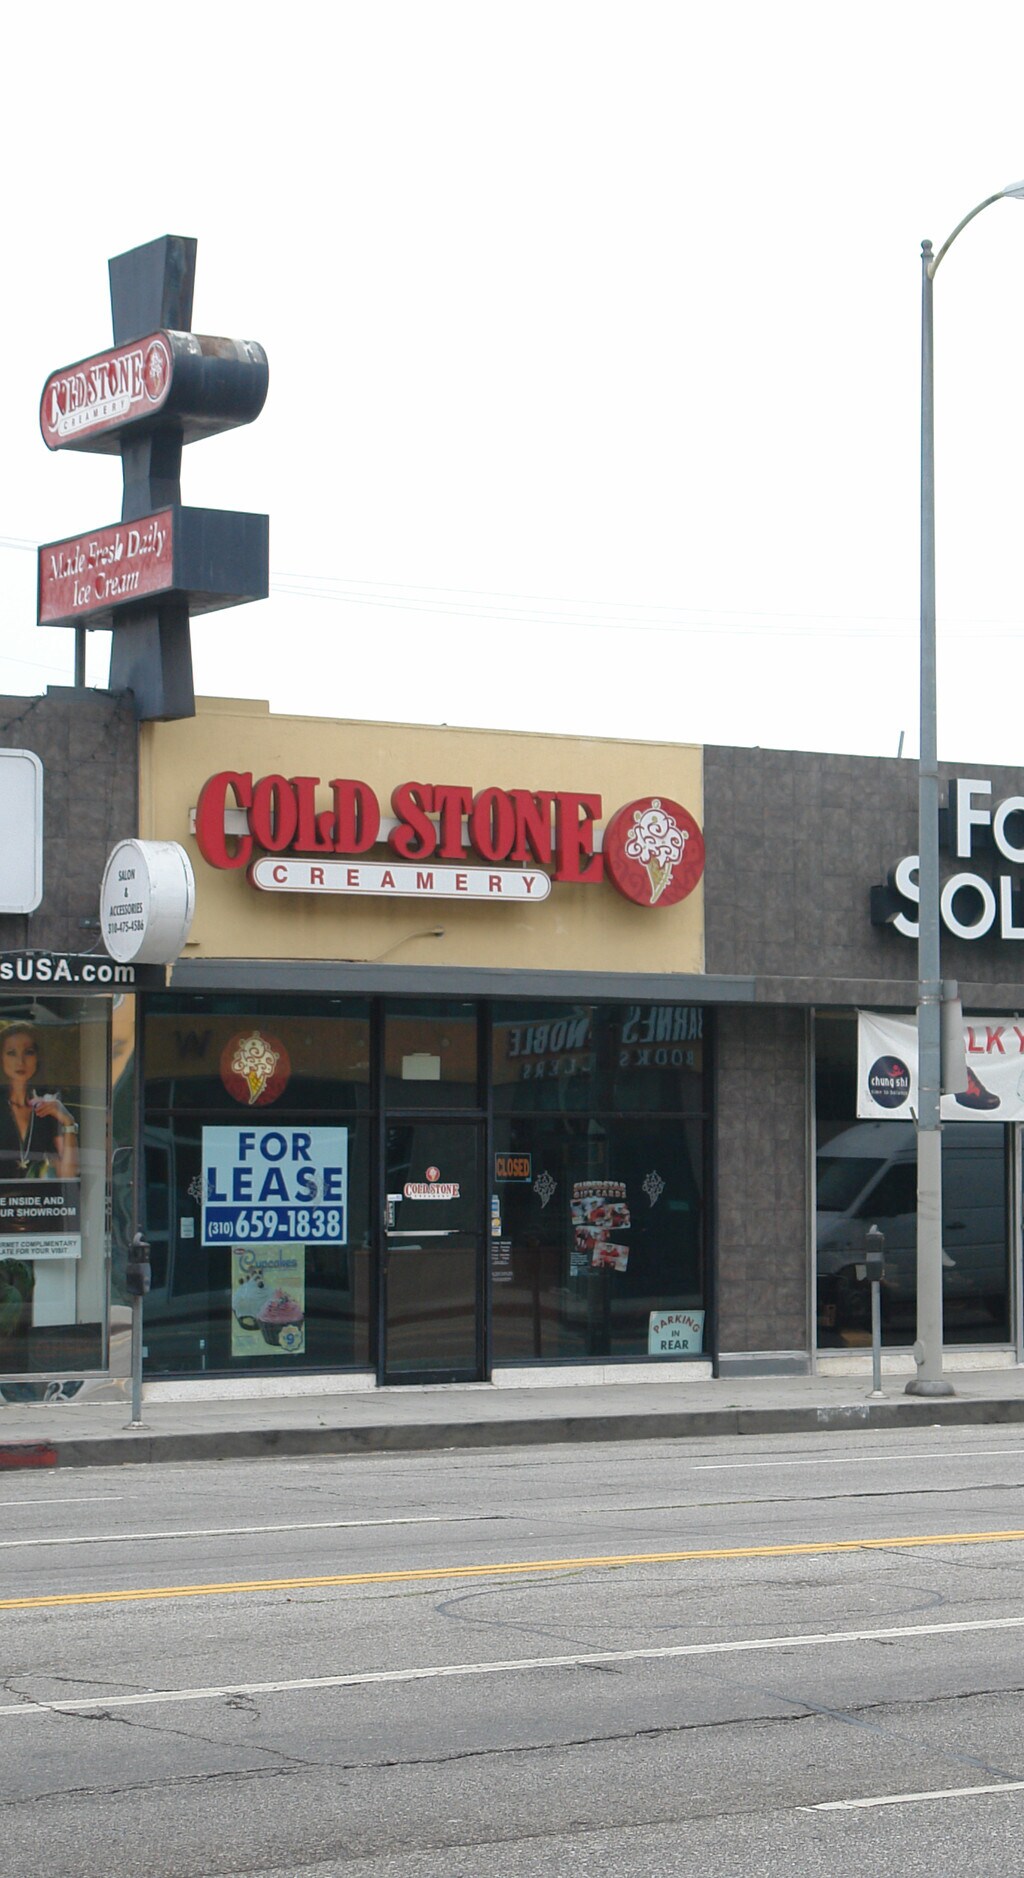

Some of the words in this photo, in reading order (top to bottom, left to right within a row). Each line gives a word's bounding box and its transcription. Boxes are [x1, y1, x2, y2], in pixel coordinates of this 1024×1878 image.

[84, 351, 143, 406] STONE
[62, 400, 126, 431] CREAMERY
[50, 545, 85, 580] Made
[88, 533, 123, 568] Fresh
[127, 521, 166, 557] Daily
[73, 580, 91, 607] Ice
[95, 571, 139, 600] Cream
[196, 770, 380, 870] COLD
[389, 781, 602, 883] STONE
[118, 869, 135, 881] SALON
[272, 866, 536, 893] CREAMERY
[110, 902, 143, 916] ACCESSORIES
[0, 957, 135, 982] sUSA.com
[966, 1026, 1006, 1055] LK
[871, 1075, 894, 1088] chung
[896, 1076, 908, 1087] shi
[239, 1132, 312, 1161] FOR
[496, 1158, 530, 1177] CLOSED
[208, 1167, 342, 1202] LEASE
[405, 1183, 428, 1196] COLD
[430, 1183, 459, 1197] STONE
[596, 1189, 626, 1198] CARDS
[9, 1197, 41, 1206] INSIDE
[43, 1197, 64, 1205] AND
[16, 1207, 76, 1217] SHOWROOM
[209, 1221, 233, 1238] (310)
[236, 1210, 340, 1238] 659-1838
[21, 1240, 77, 1248] COMPLIMENTARY
[239, 1248, 298, 1273] Cupcakes
[653, 1314, 700, 1334] PARKING
[660, 1340, 689, 1350] REAR
